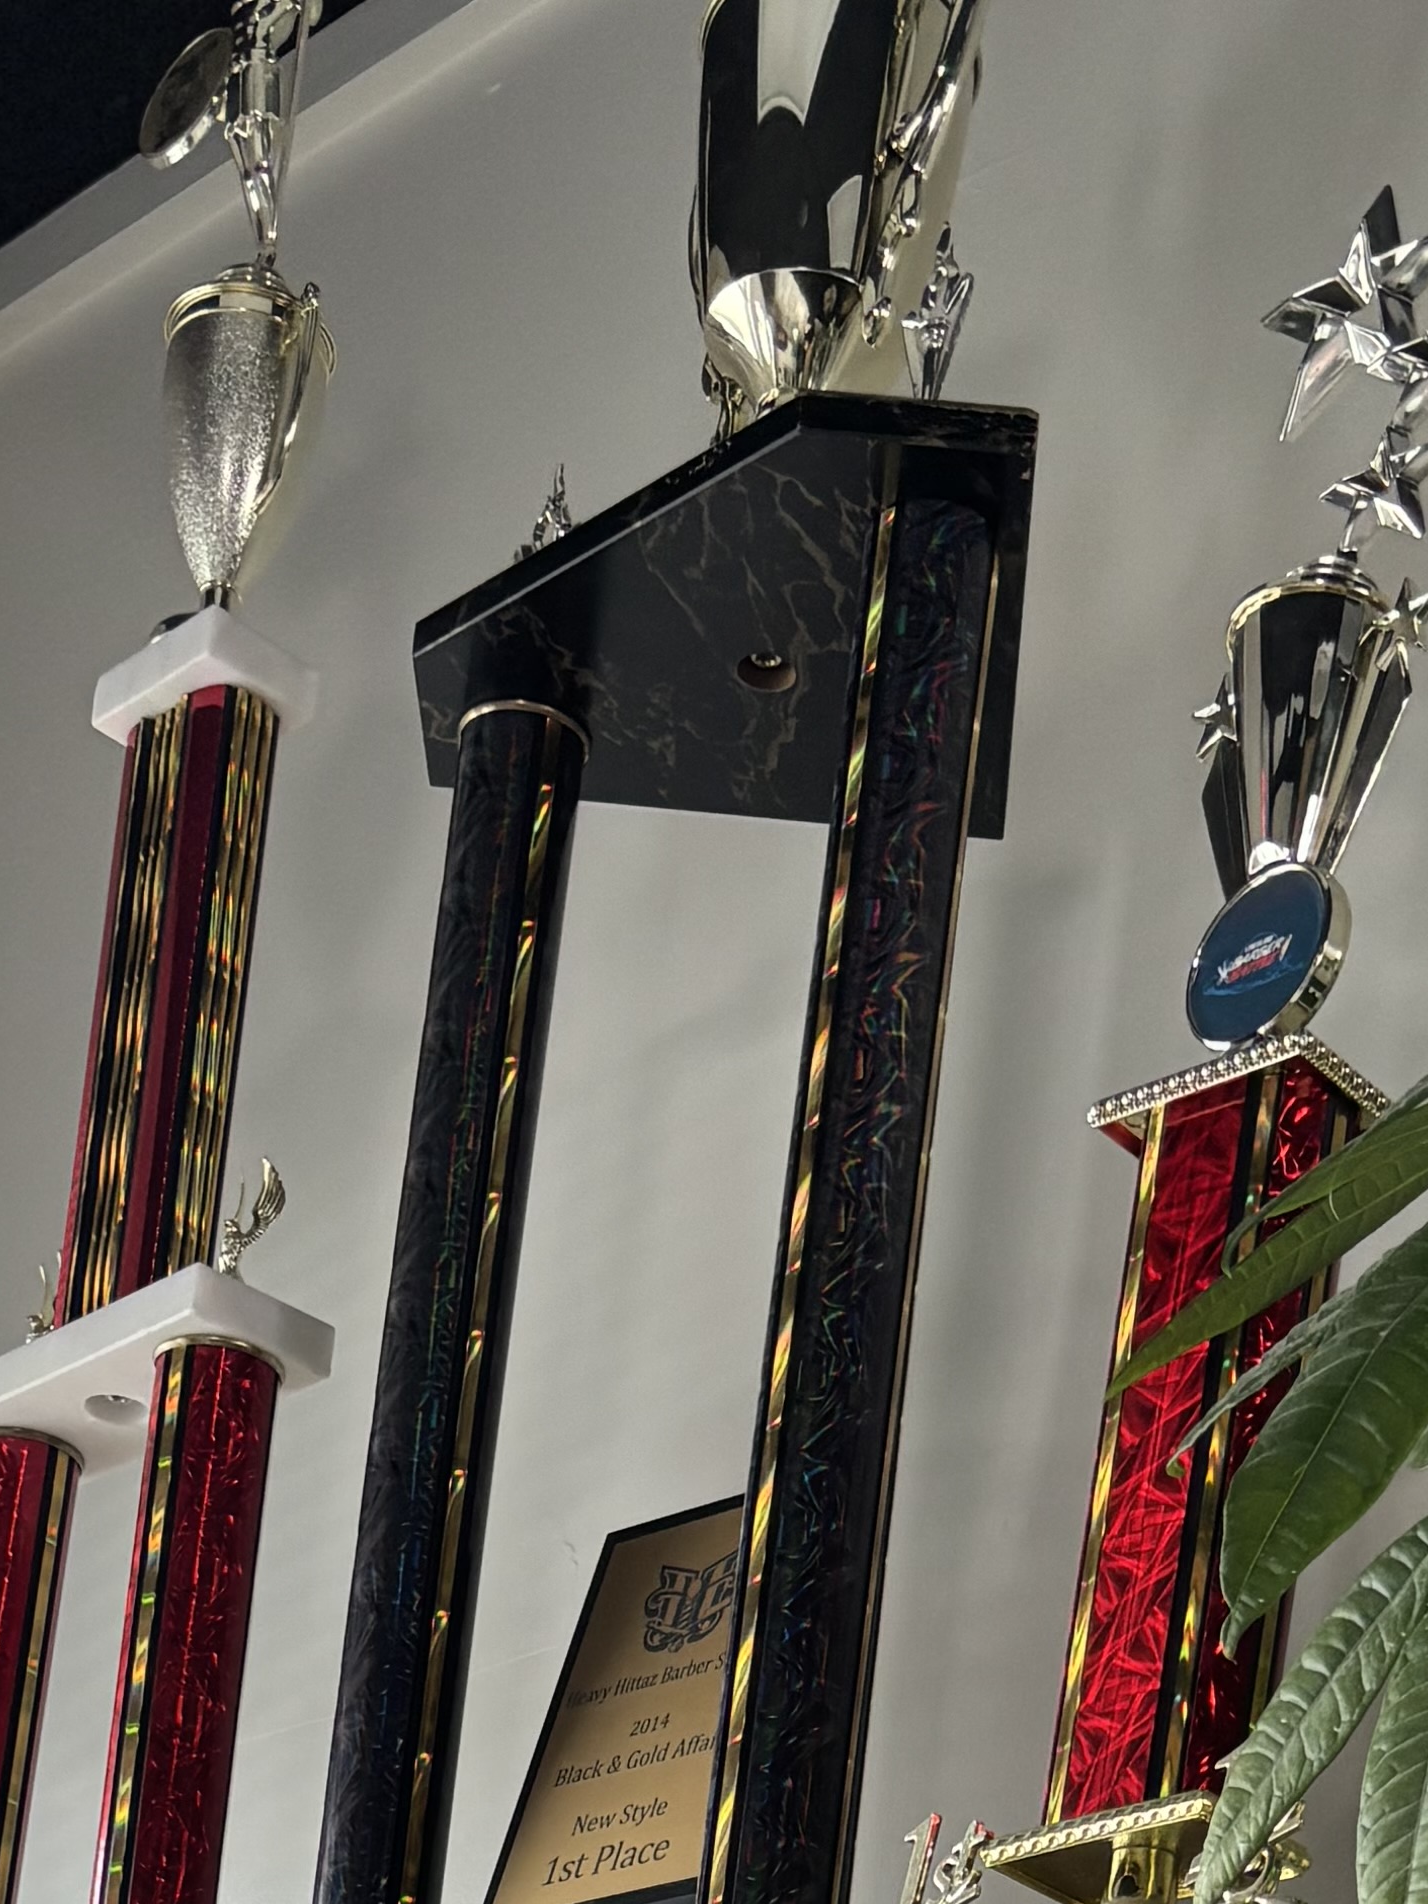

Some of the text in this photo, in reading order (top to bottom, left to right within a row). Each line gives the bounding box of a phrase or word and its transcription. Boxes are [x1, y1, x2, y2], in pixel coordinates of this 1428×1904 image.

[614, 1673, 659, 1697] Hittaz
[660, 1659, 712, 1685] Barber
[629, 1712, 671, 1737] 2014
[554, 1760, 603, 1787] Black
[607, 1755, 622, 1775] &
[626, 1742, 671, 1770] Gold
[571, 1797, 668, 1836] New Style
[542, 1840, 670, 1886] 1st Place
